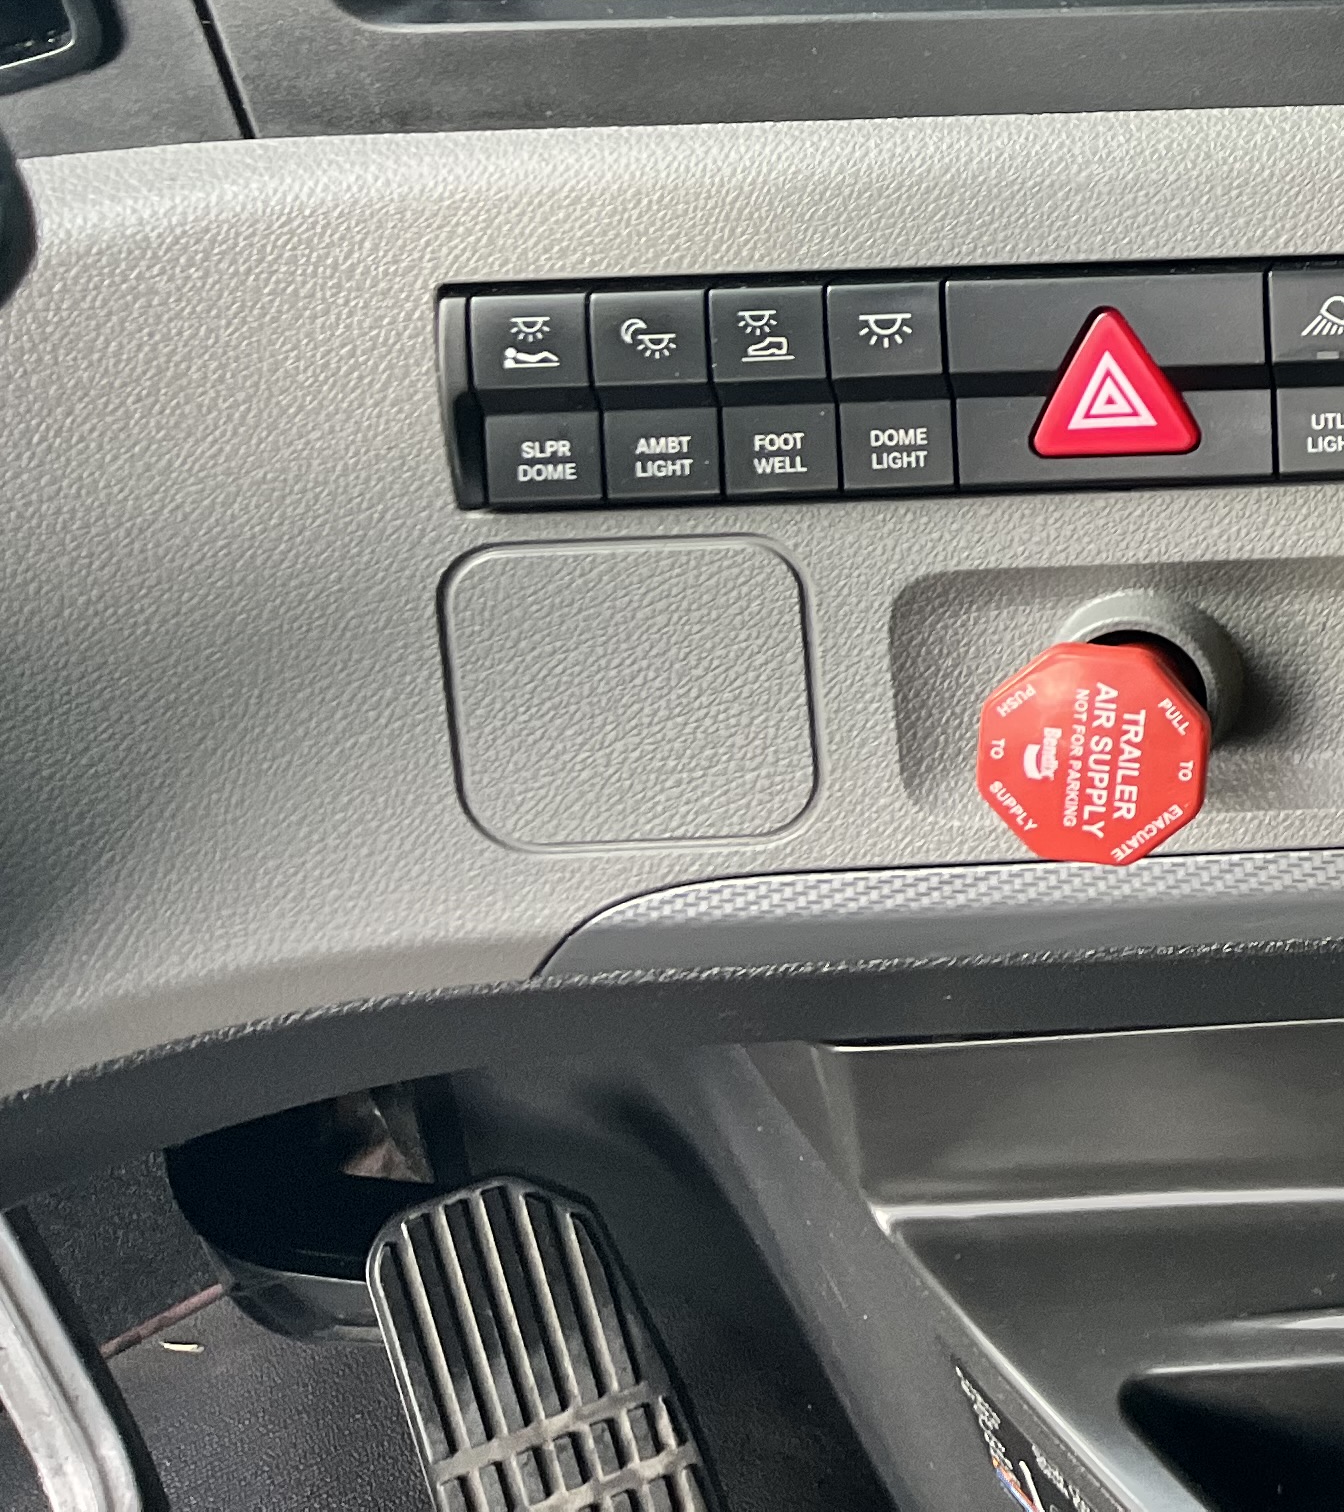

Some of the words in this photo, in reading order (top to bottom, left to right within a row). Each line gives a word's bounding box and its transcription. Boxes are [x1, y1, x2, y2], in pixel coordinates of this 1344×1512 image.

[520, 439, 572, 459] SLPR
[634, 436, 691, 455] AMBT
[753, 433, 805, 452] FOOT
[869, 427, 928, 448] DOME
[517, 462, 578, 482] DOME
[635, 457, 694, 478] LIGHT
[753, 455, 808, 475] WELL
[870, 449, 928, 471] LIGHT
[996, 683, 1037, 718] PUSH
[1073, 687, 1090, 723] NOT
[1091, 681, 1119, 729] AIR
[1157, 697, 1190, 736] PULL
[990, 738, 1006, 760] TO
[1069, 724, 1086, 757] FOR
[1112, 709, 1146, 820] TRAILER
[1177, 760, 1194, 782] TO
[1062, 759, 1083, 828] PARKING
[1081, 736, 1113, 839] SUPPLY
[989, 780, 1038, 832] SUPPLY
[1110, 803, 1184, 862] EVACUATE
